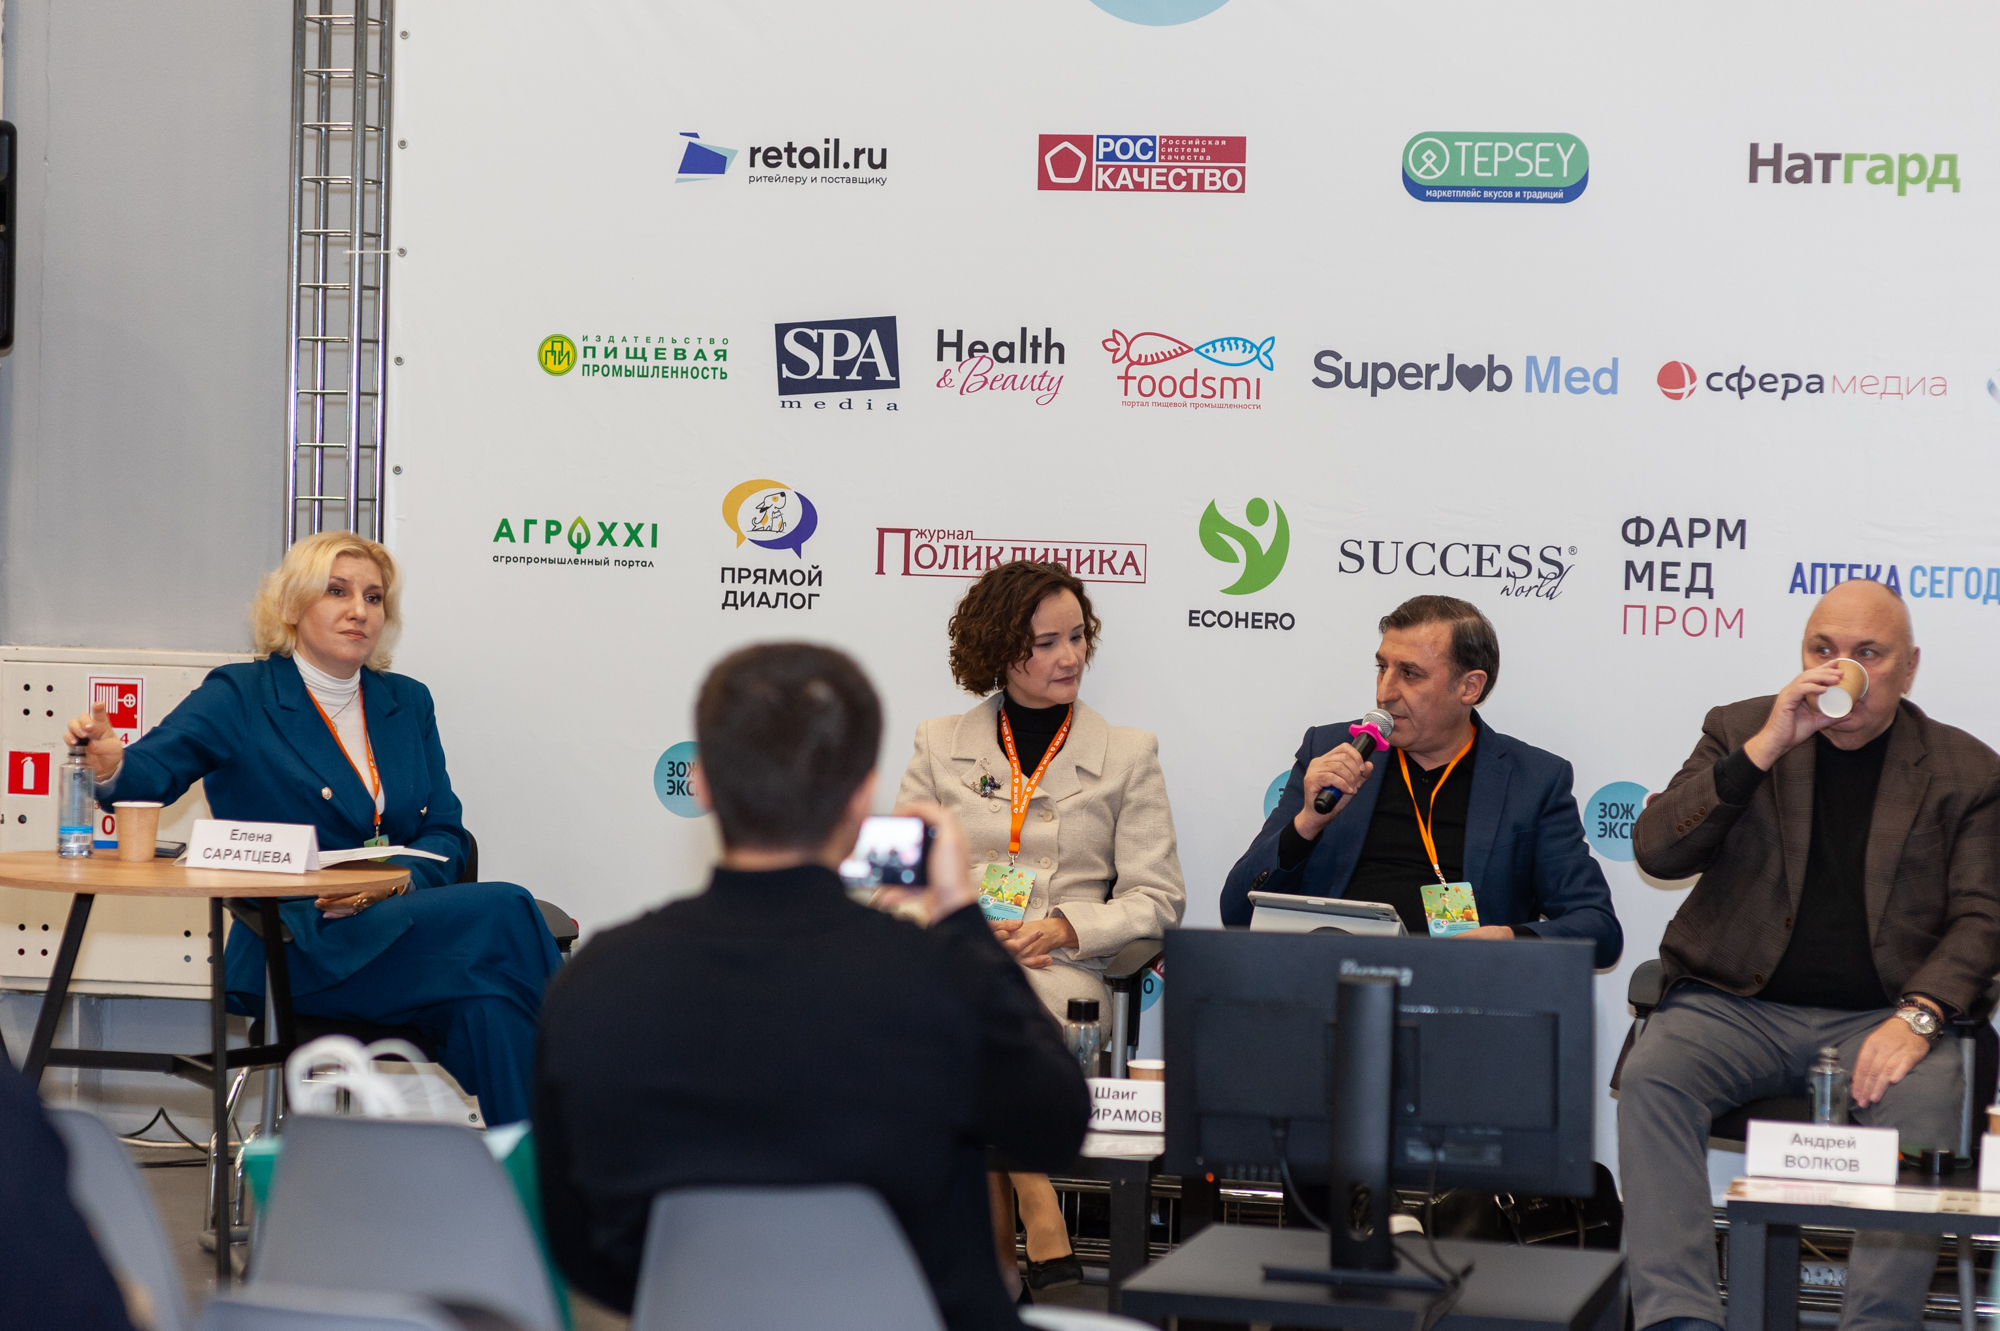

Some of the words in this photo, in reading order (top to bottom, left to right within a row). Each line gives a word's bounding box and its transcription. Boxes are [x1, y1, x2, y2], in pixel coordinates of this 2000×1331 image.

[1098, 137, 1154, 161] РОС
[1161, 138, 1227, 146] Российская
[1161, 146, 1206, 154] система
[749, 138, 887, 170] retail.ru
[1160, 154, 1212, 162] качества
[1454, 142, 1576, 177] TEPSEY
[1749, 143, 1961, 196] Натгард
[748, 174, 808, 185] ритейлеру
[811, 176, 818, 184] и
[820, 176, 887, 186] поставщику
[1097, 167, 1243, 191] КАЧЕСТВО
[1425, 188, 1482, 199] маркетплейс
[1483, 190, 1513, 200] вкусов
[1523, 189, 1564, 200] традиций
[582, 335, 729, 345] ИЗДАТЕЛЬСТВО
[936, 327, 1065, 364] Health
[583, 346, 727, 362] ПИЩЕВАЯ
[781, 327, 896, 380] SPA
[582, 364, 728, 380] ПРОМЫШЛЕННОСТЬ
[936, 368, 954, 388] &
[958, 354, 1064, 405] Beauty
[1117, 363, 1260, 399] foodsmi
[1525, 355, 1618, 395] Med
[780, 399, 899, 411] media
[1121, 400, 1149, 409] портал
[1151, 400, 1187, 409] пищевой
[1190, 401, 1261, 410] промышленности
[915, 529, 973, 542] журнал
[1621, 516, 1746, 549] ФАРМ
[492, 556, 610, 566] агропромышленный
[614, 557, 654, 568] портал
[721, 565, 822, 586] ПРЯМОЙ
[1500, 564, 1575, 600] world
[1625, 560, 1714, 599] МЕД
[722, 591, 820, 610] ДИАЛОГ
[1189, 610, 1295, 630] ECOHERO
[1623, 605, 1743, 638] ПРОМ
[667, 779, 698, 796] ЭКС
[1598, 802, 1635, 820] ЗОЖ
[230, 829, 272, 842] Елена
[203, 847, 291, 864] САРАТЦЕВА
[1094, 1087, 1138, 1100] Шаиг
[1791, 1132, 1857, 1149] Андрей
[1785, 1154, 1860, 1172] ВОЛКОВ
